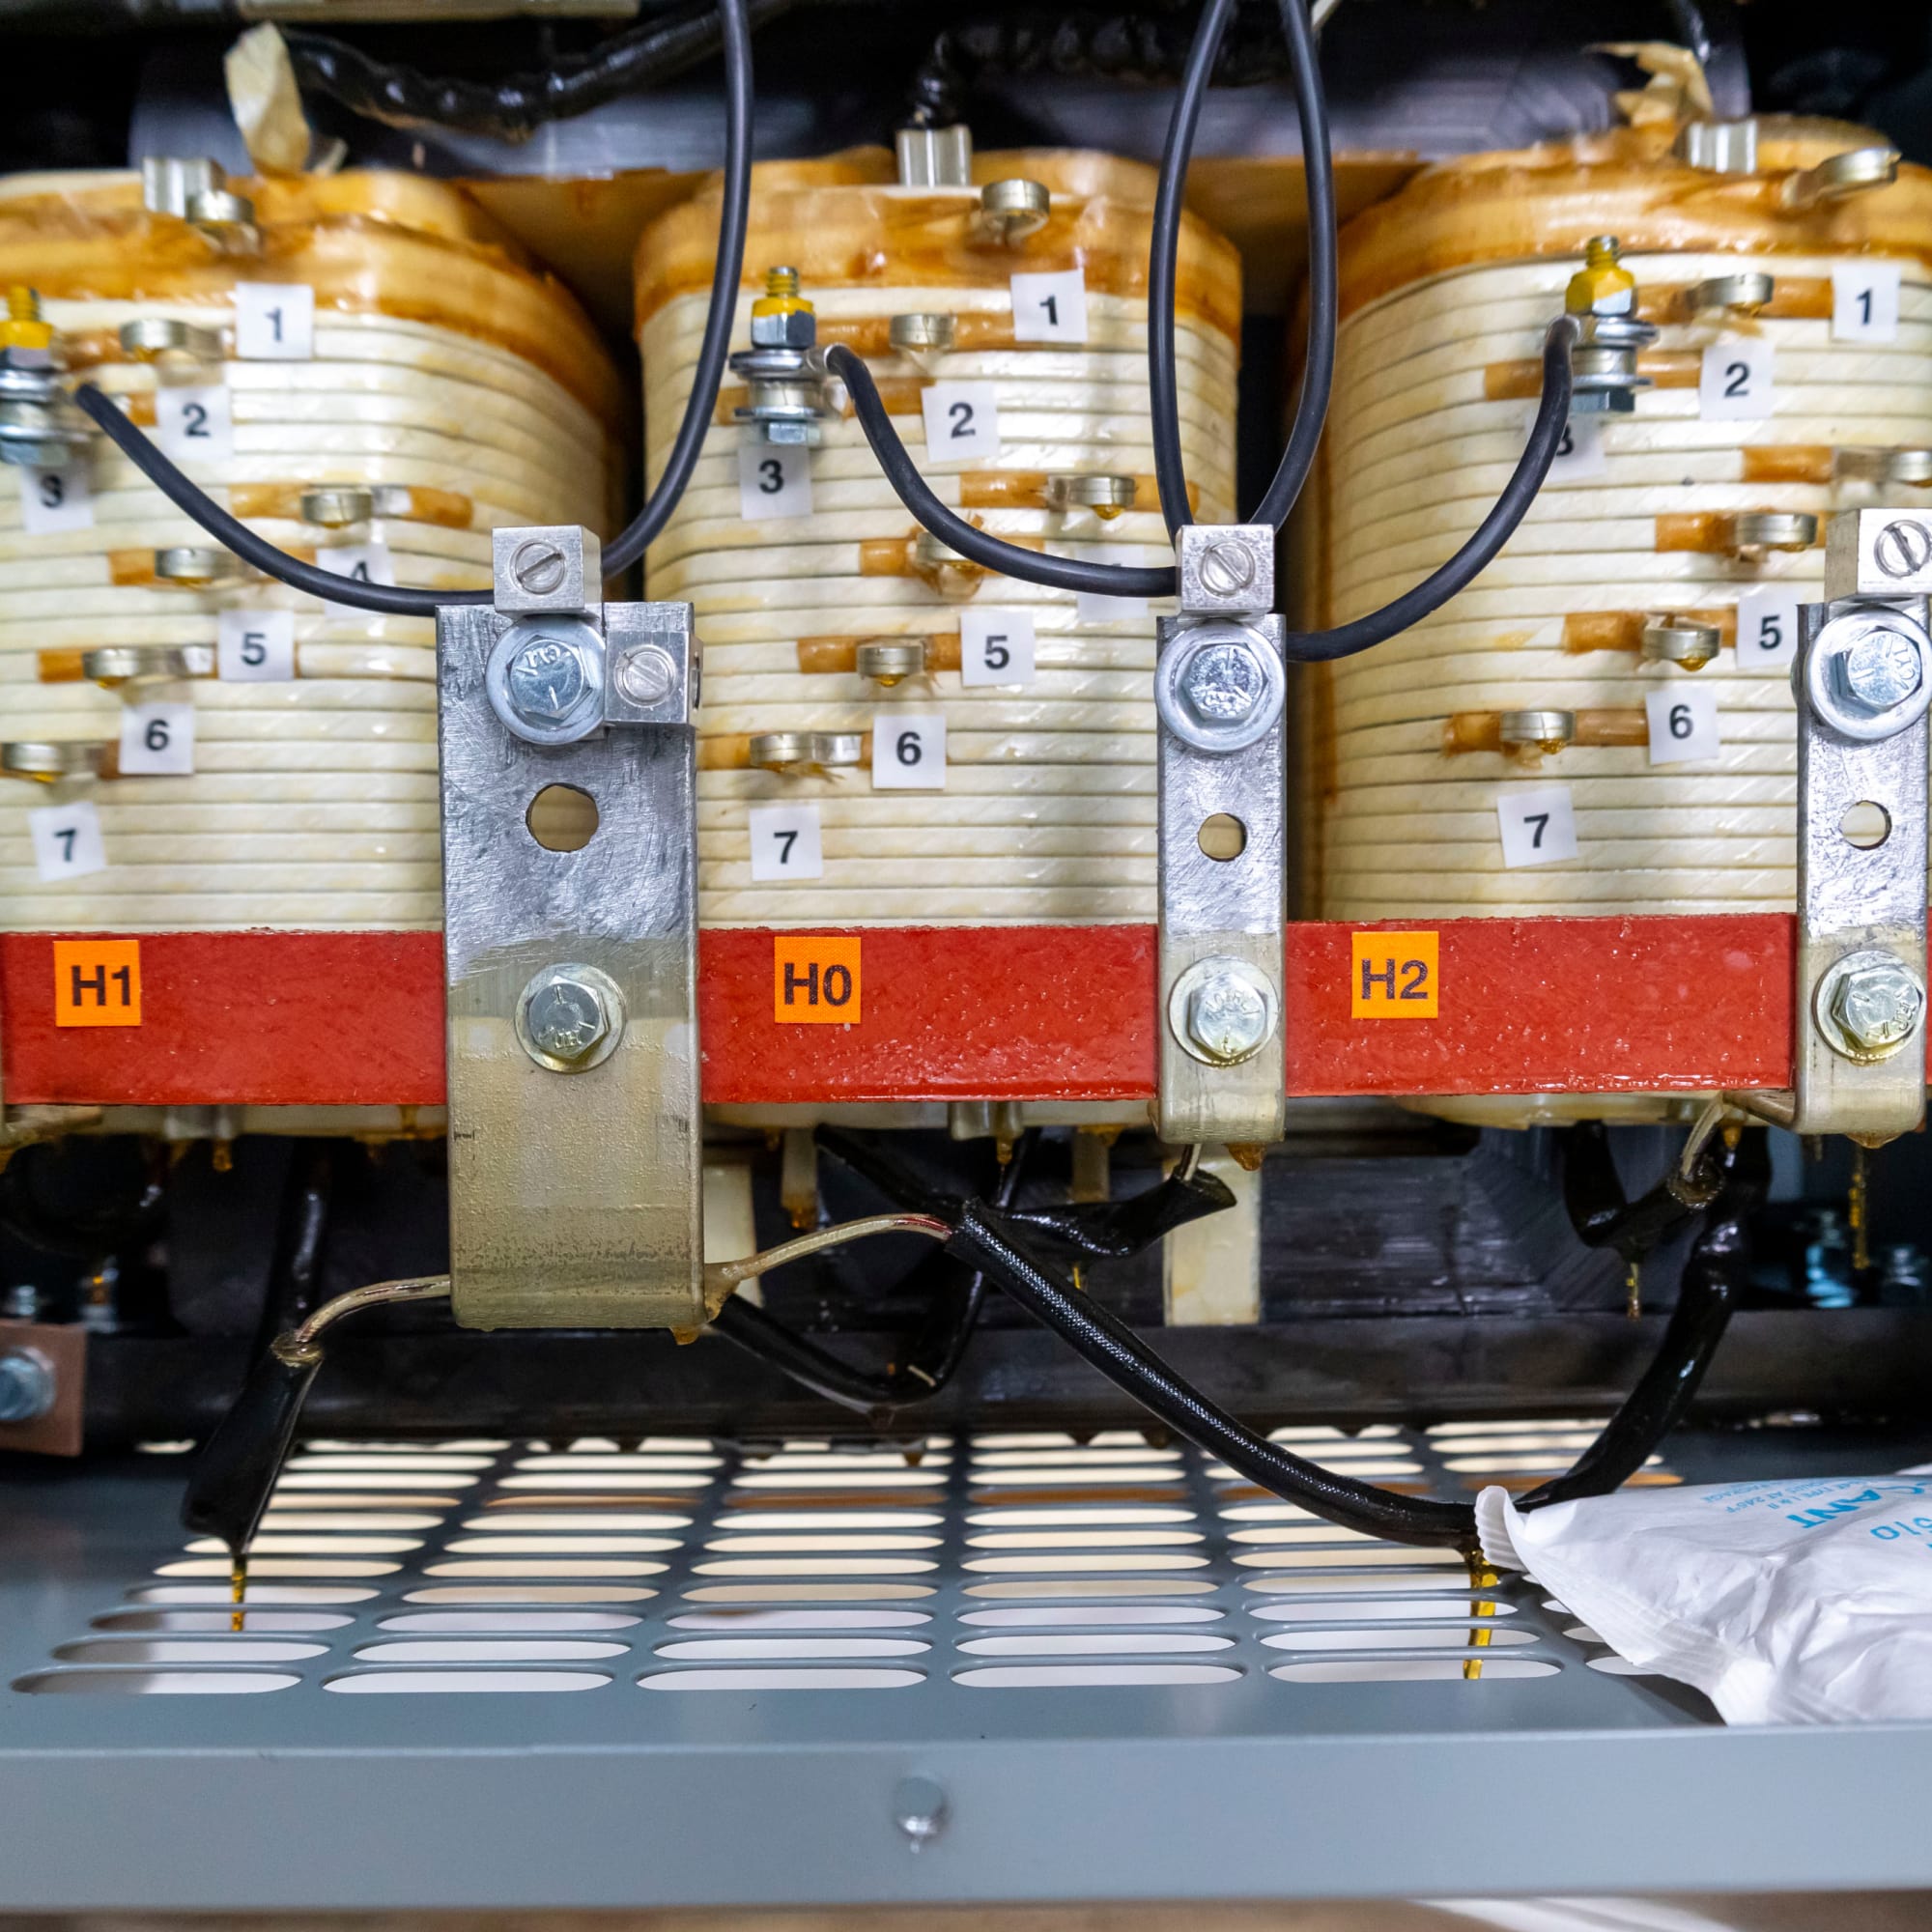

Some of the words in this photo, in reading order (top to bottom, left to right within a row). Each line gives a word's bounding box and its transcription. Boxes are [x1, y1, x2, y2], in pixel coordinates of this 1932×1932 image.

[266, 307, 283, 343] 1
[1039, 296, 1059, 326] 1
[1857, 289, 1872, 326] 1
[1724, 361, 1750, 398] 2
[181, 401, 211, 439] 2
[948, 401, 977, 440] 2
[40, 473, 64, 509] 3
[758, 457, 785, 495] 3
[241, 632, 267, 668] 5
[1758, 614, 1782, 651] 5
[983, 635, 1010, 670] 5
[143, 718, 170, 753] 6
[1668, 703, 1693, 740] 6
[895, 730, 923, 766] 6
[53, 827, 78, 863] 7
[773, 830, 799, 865] 7
[1523, 812, 1549, 849] 7
[71, 964, 133, 1007] H1
[783, 962, 852, 1007] H0
[1361, 958, 1429, 1001] H2
[1786, 1481, 1932, 1528] CANT
